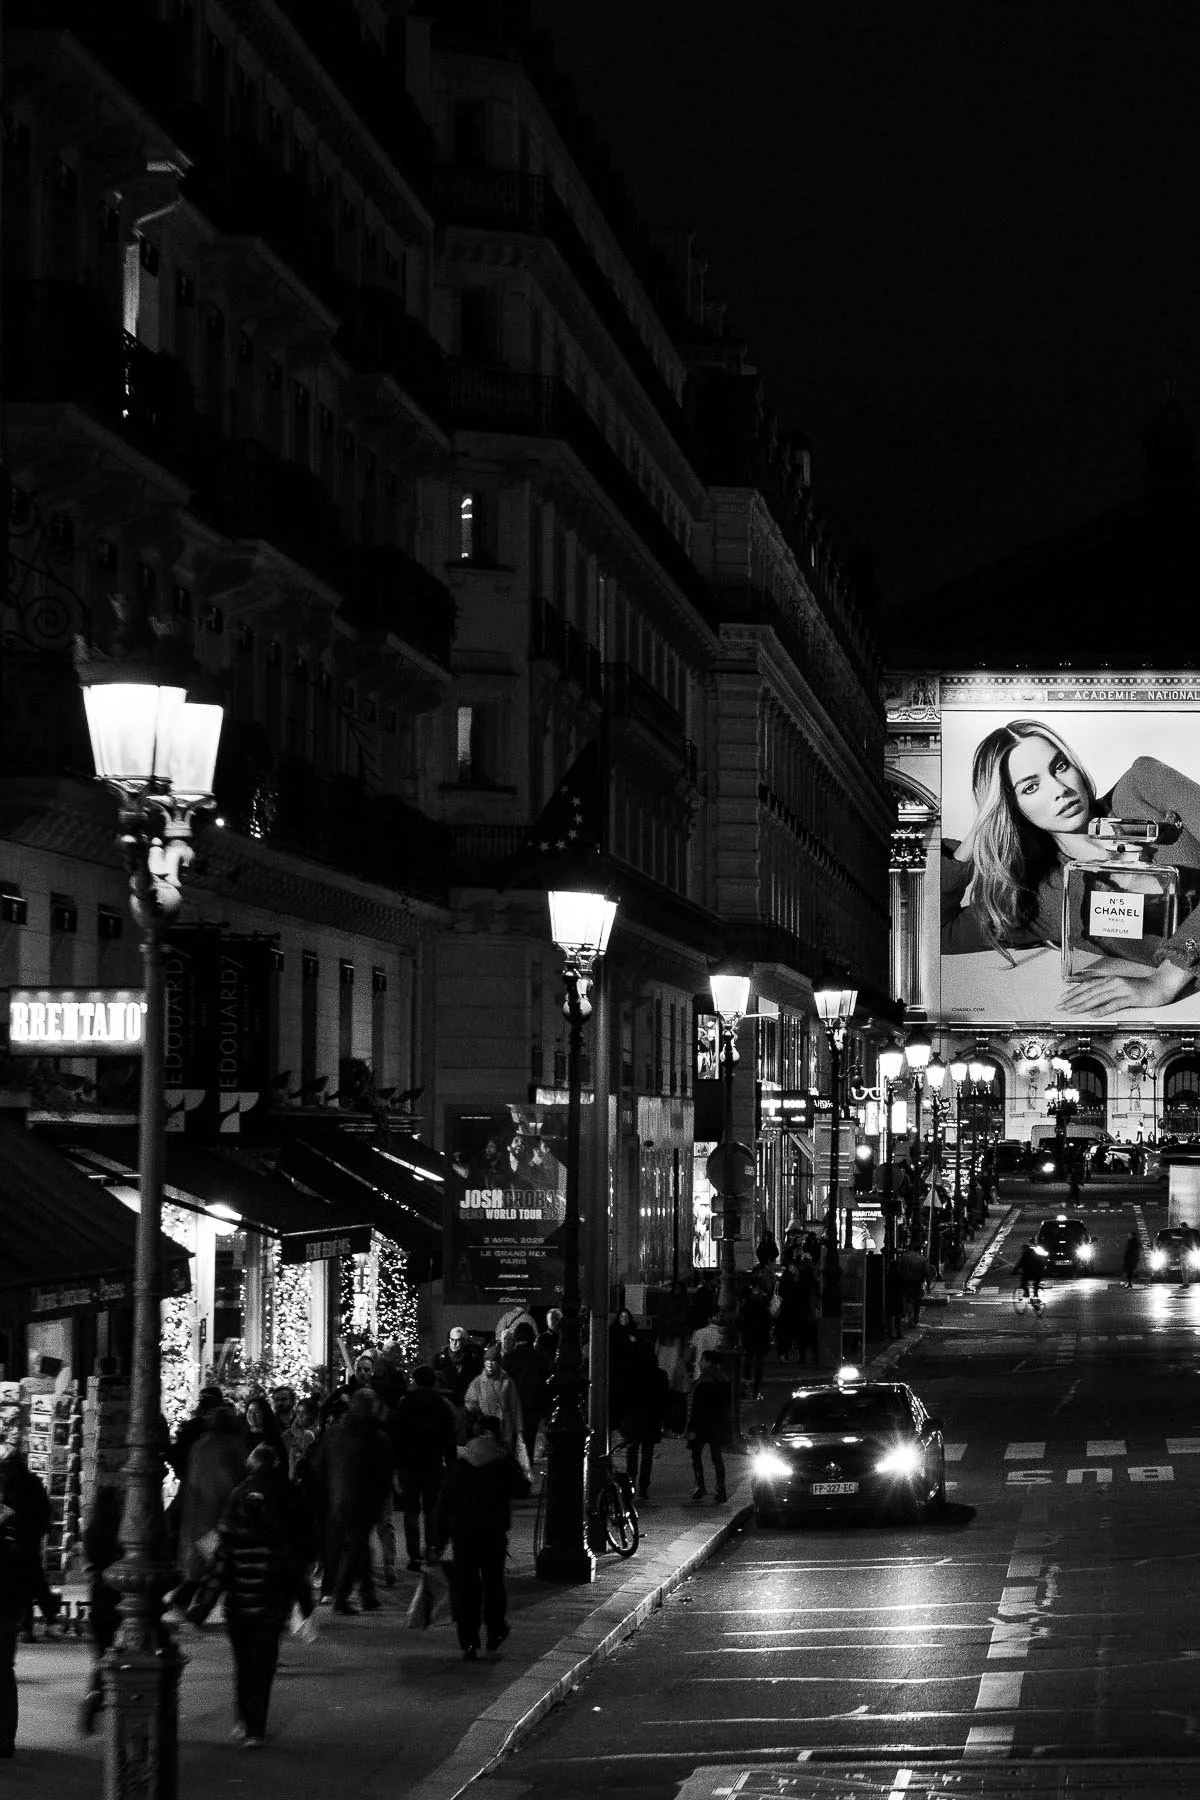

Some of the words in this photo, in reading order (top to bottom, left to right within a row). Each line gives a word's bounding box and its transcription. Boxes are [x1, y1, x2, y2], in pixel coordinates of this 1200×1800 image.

[1074, 690, 1137, 700] ACADEMIE
[1094, 906, 1140, 917] CHANEL
[10, 1002, 148, 1041] BRENTANO'
[459, 1189, 503, 1209] JOSH
[485, 1208, 517, 1220] WORLD
[518, 1208, 542, 1220] TOUR
[1004, 1465, 1176, 1486] BUS
